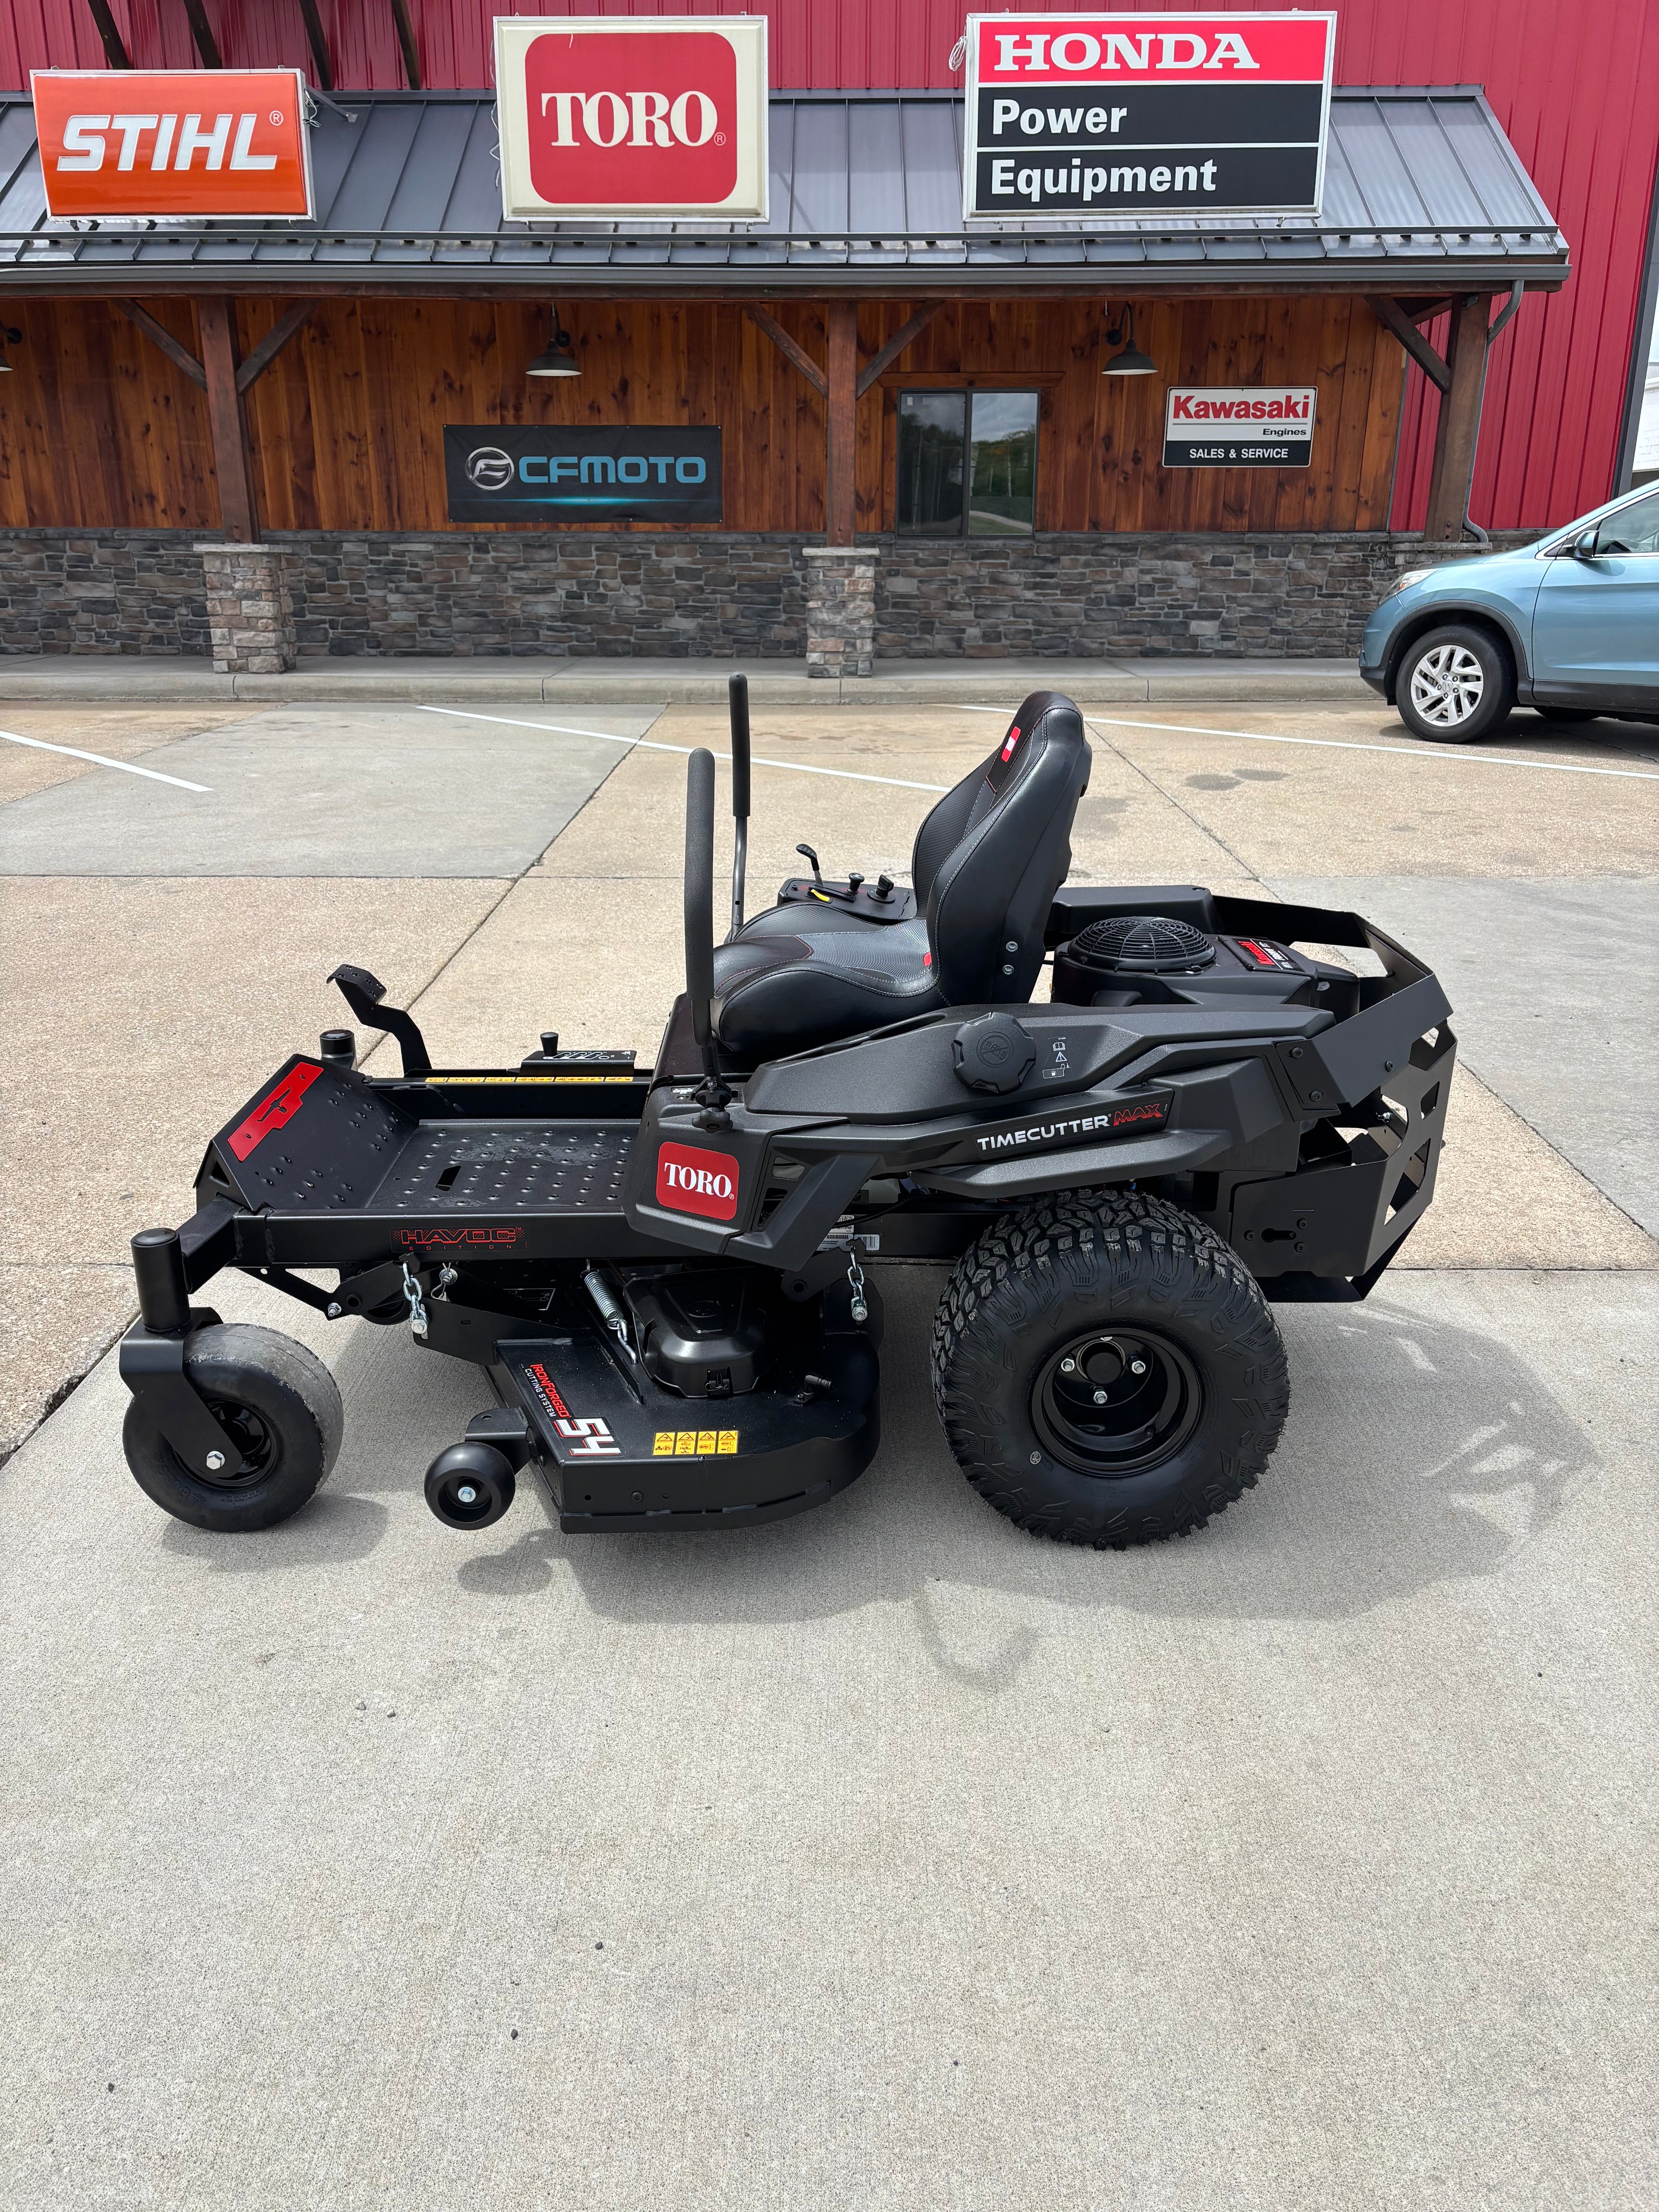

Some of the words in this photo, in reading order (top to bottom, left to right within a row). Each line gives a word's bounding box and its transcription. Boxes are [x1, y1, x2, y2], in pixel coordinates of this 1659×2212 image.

[994, 33, 1260, 71] HONDA
[993, 99, 1127, 135] Power
[991, 158, 1217, 202] Equipment
[1173, 395, 1310, 419] Kawasaki
[1263, 428, 1307, 437] Engines
[1189, 448, 1224, 459] SALES
[1229, 449, 1237, 458] &
[1241, 448, 1288, 459] SERVICE
[519, 456, 706, 483] CFMOTO
[1113, 1103, 1163, 1126] MAX
[525, 1368, 543, 1393] CUTTING
[538, 1393, 556, 1417] SYSTEM
[553, 1418, 621, 1456] 54
